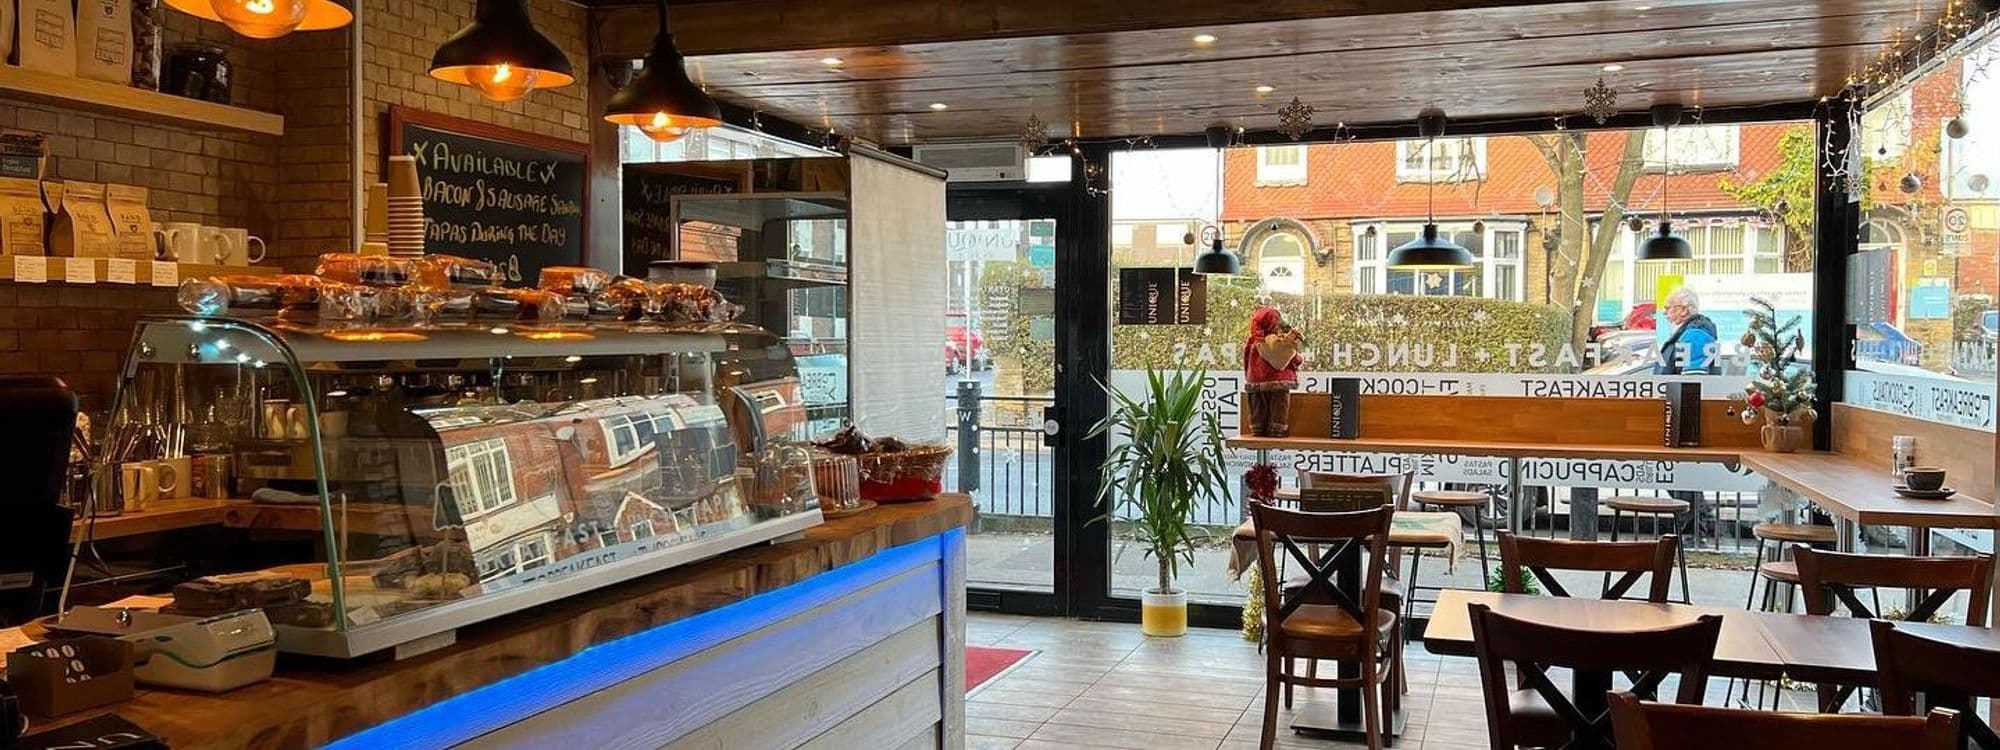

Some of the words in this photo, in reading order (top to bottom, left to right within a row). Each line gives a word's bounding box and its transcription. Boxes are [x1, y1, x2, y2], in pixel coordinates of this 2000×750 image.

[433, 142, 539, 183] AVAILABLE
[541, 223, 566, 247] DAY
[1147, 281, 1159, 323] UNIQUE
[1181, 280, 1192, 323] UNIQUE
[1332, 393, 1342, 438] UNIQUE
